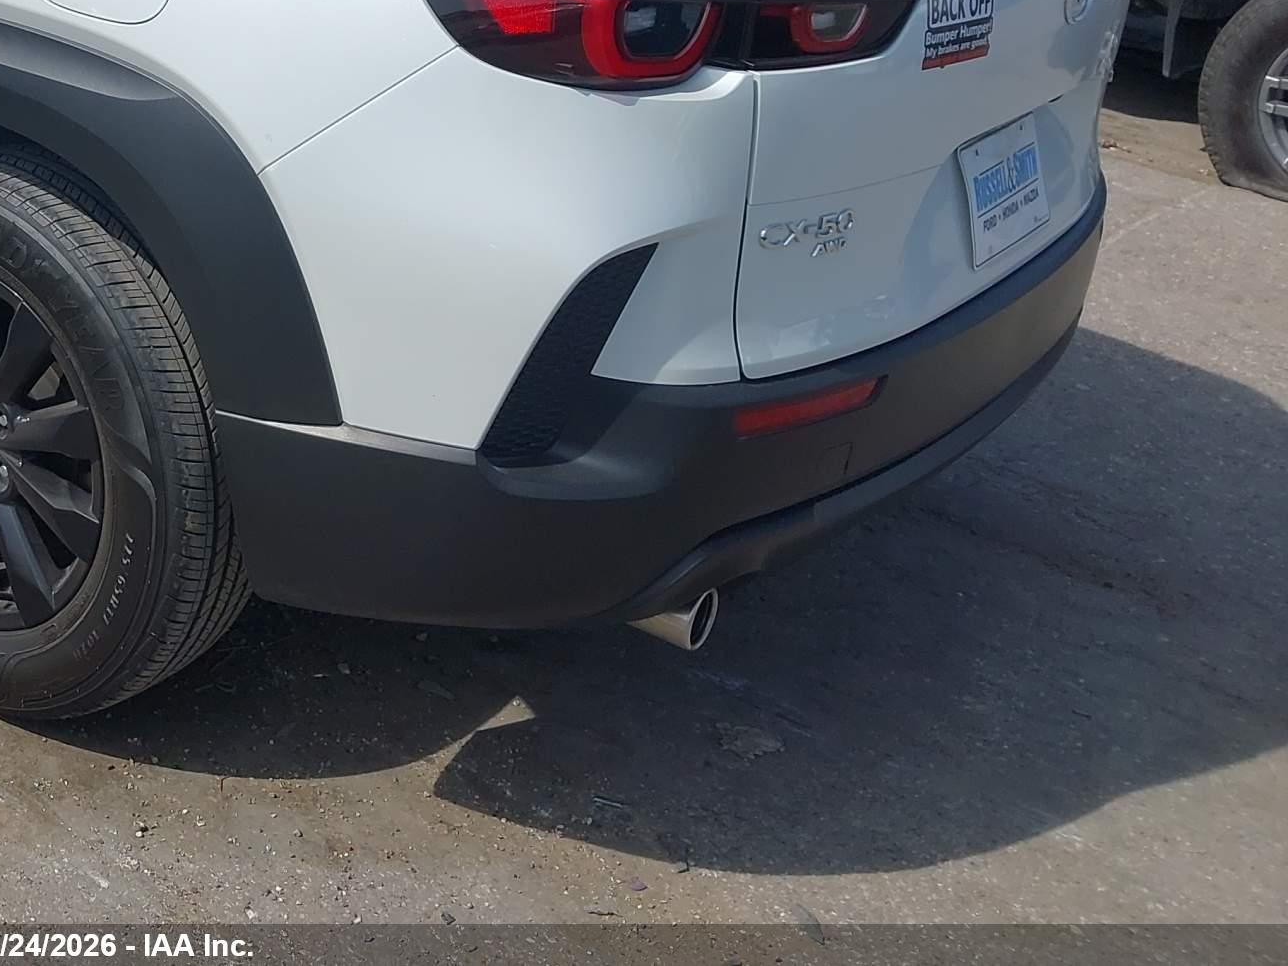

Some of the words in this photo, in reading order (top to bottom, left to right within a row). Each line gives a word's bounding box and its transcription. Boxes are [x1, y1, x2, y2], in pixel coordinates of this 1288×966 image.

[925, 30, 959, 46] Bumper
[759, 208, 854, 249] CX-50
[982, 213, 998, 233] FORD
